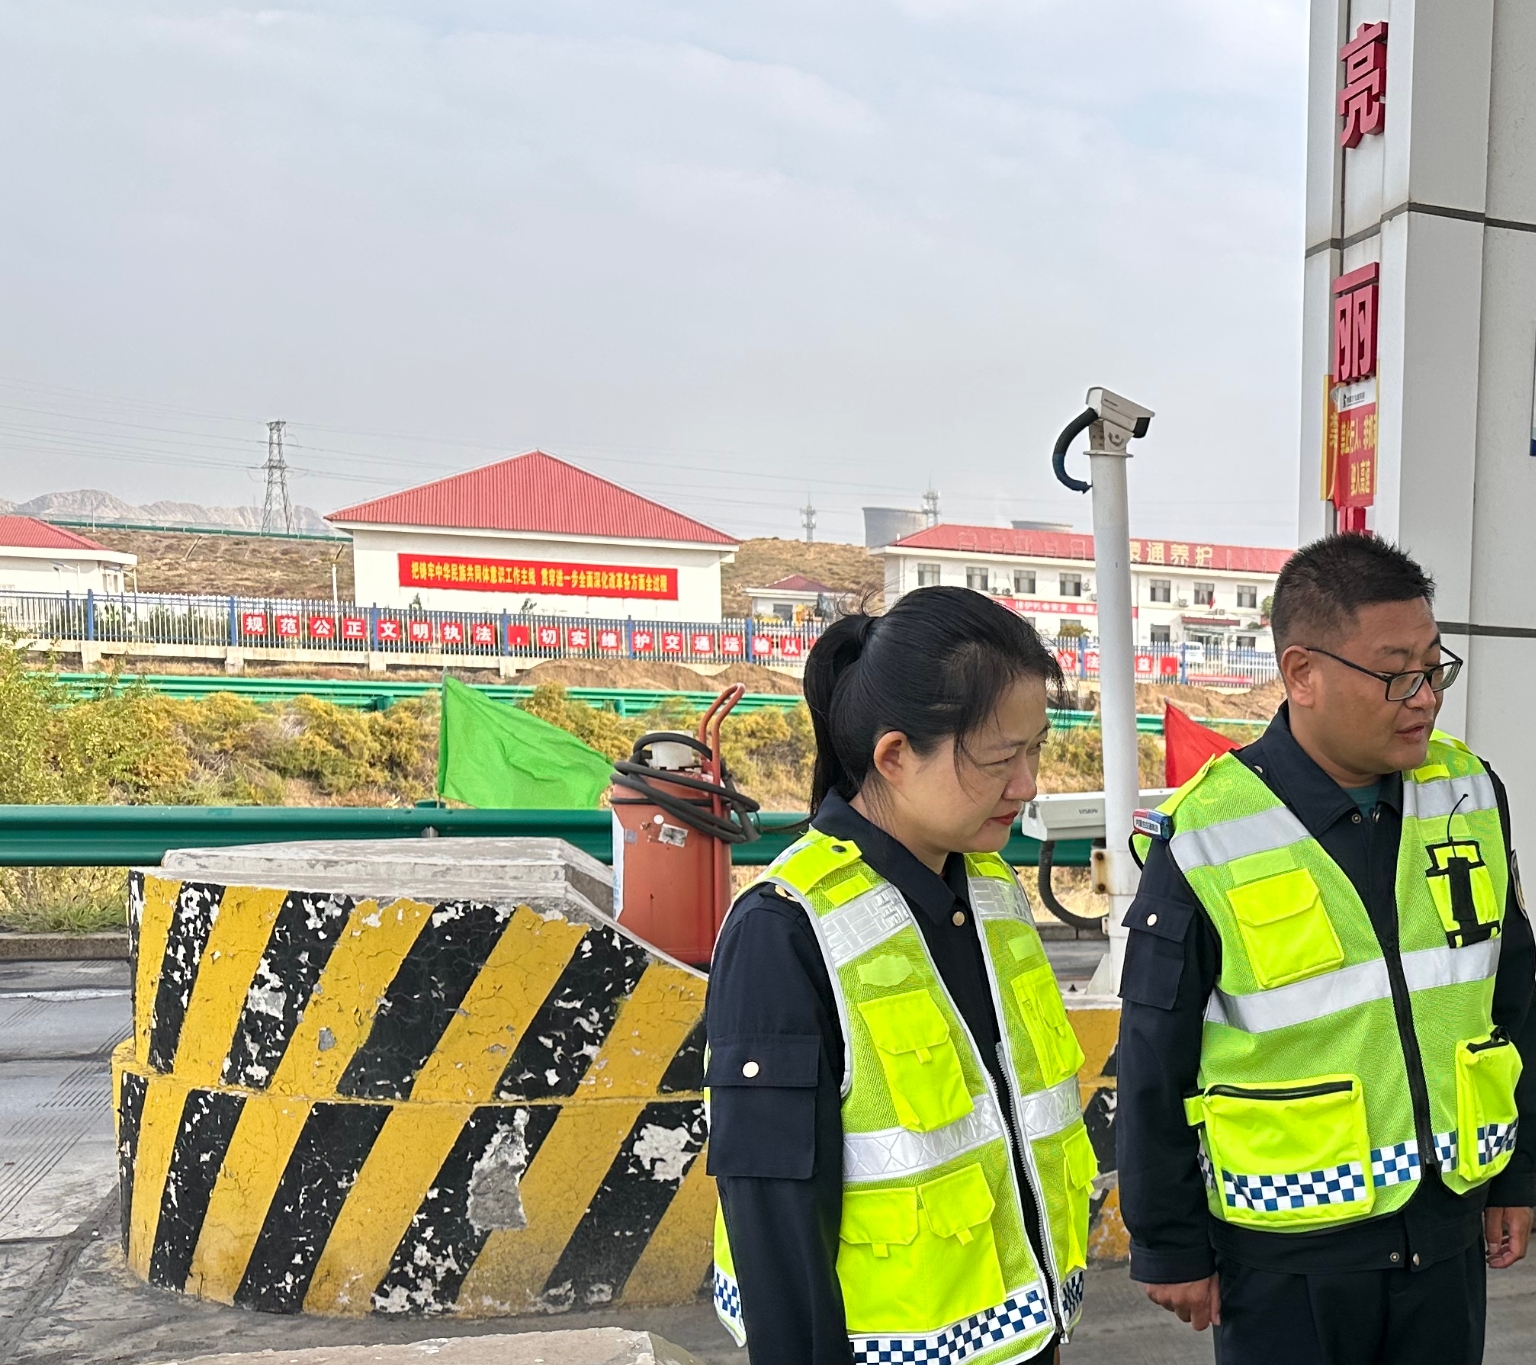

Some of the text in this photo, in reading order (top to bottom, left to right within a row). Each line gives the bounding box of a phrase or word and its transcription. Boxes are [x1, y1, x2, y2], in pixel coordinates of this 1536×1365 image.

[411, 560, 668, 592] 把铸牢中华民族共同体意识工作主线 贯穿进一步全面深化改革各方面全过程
